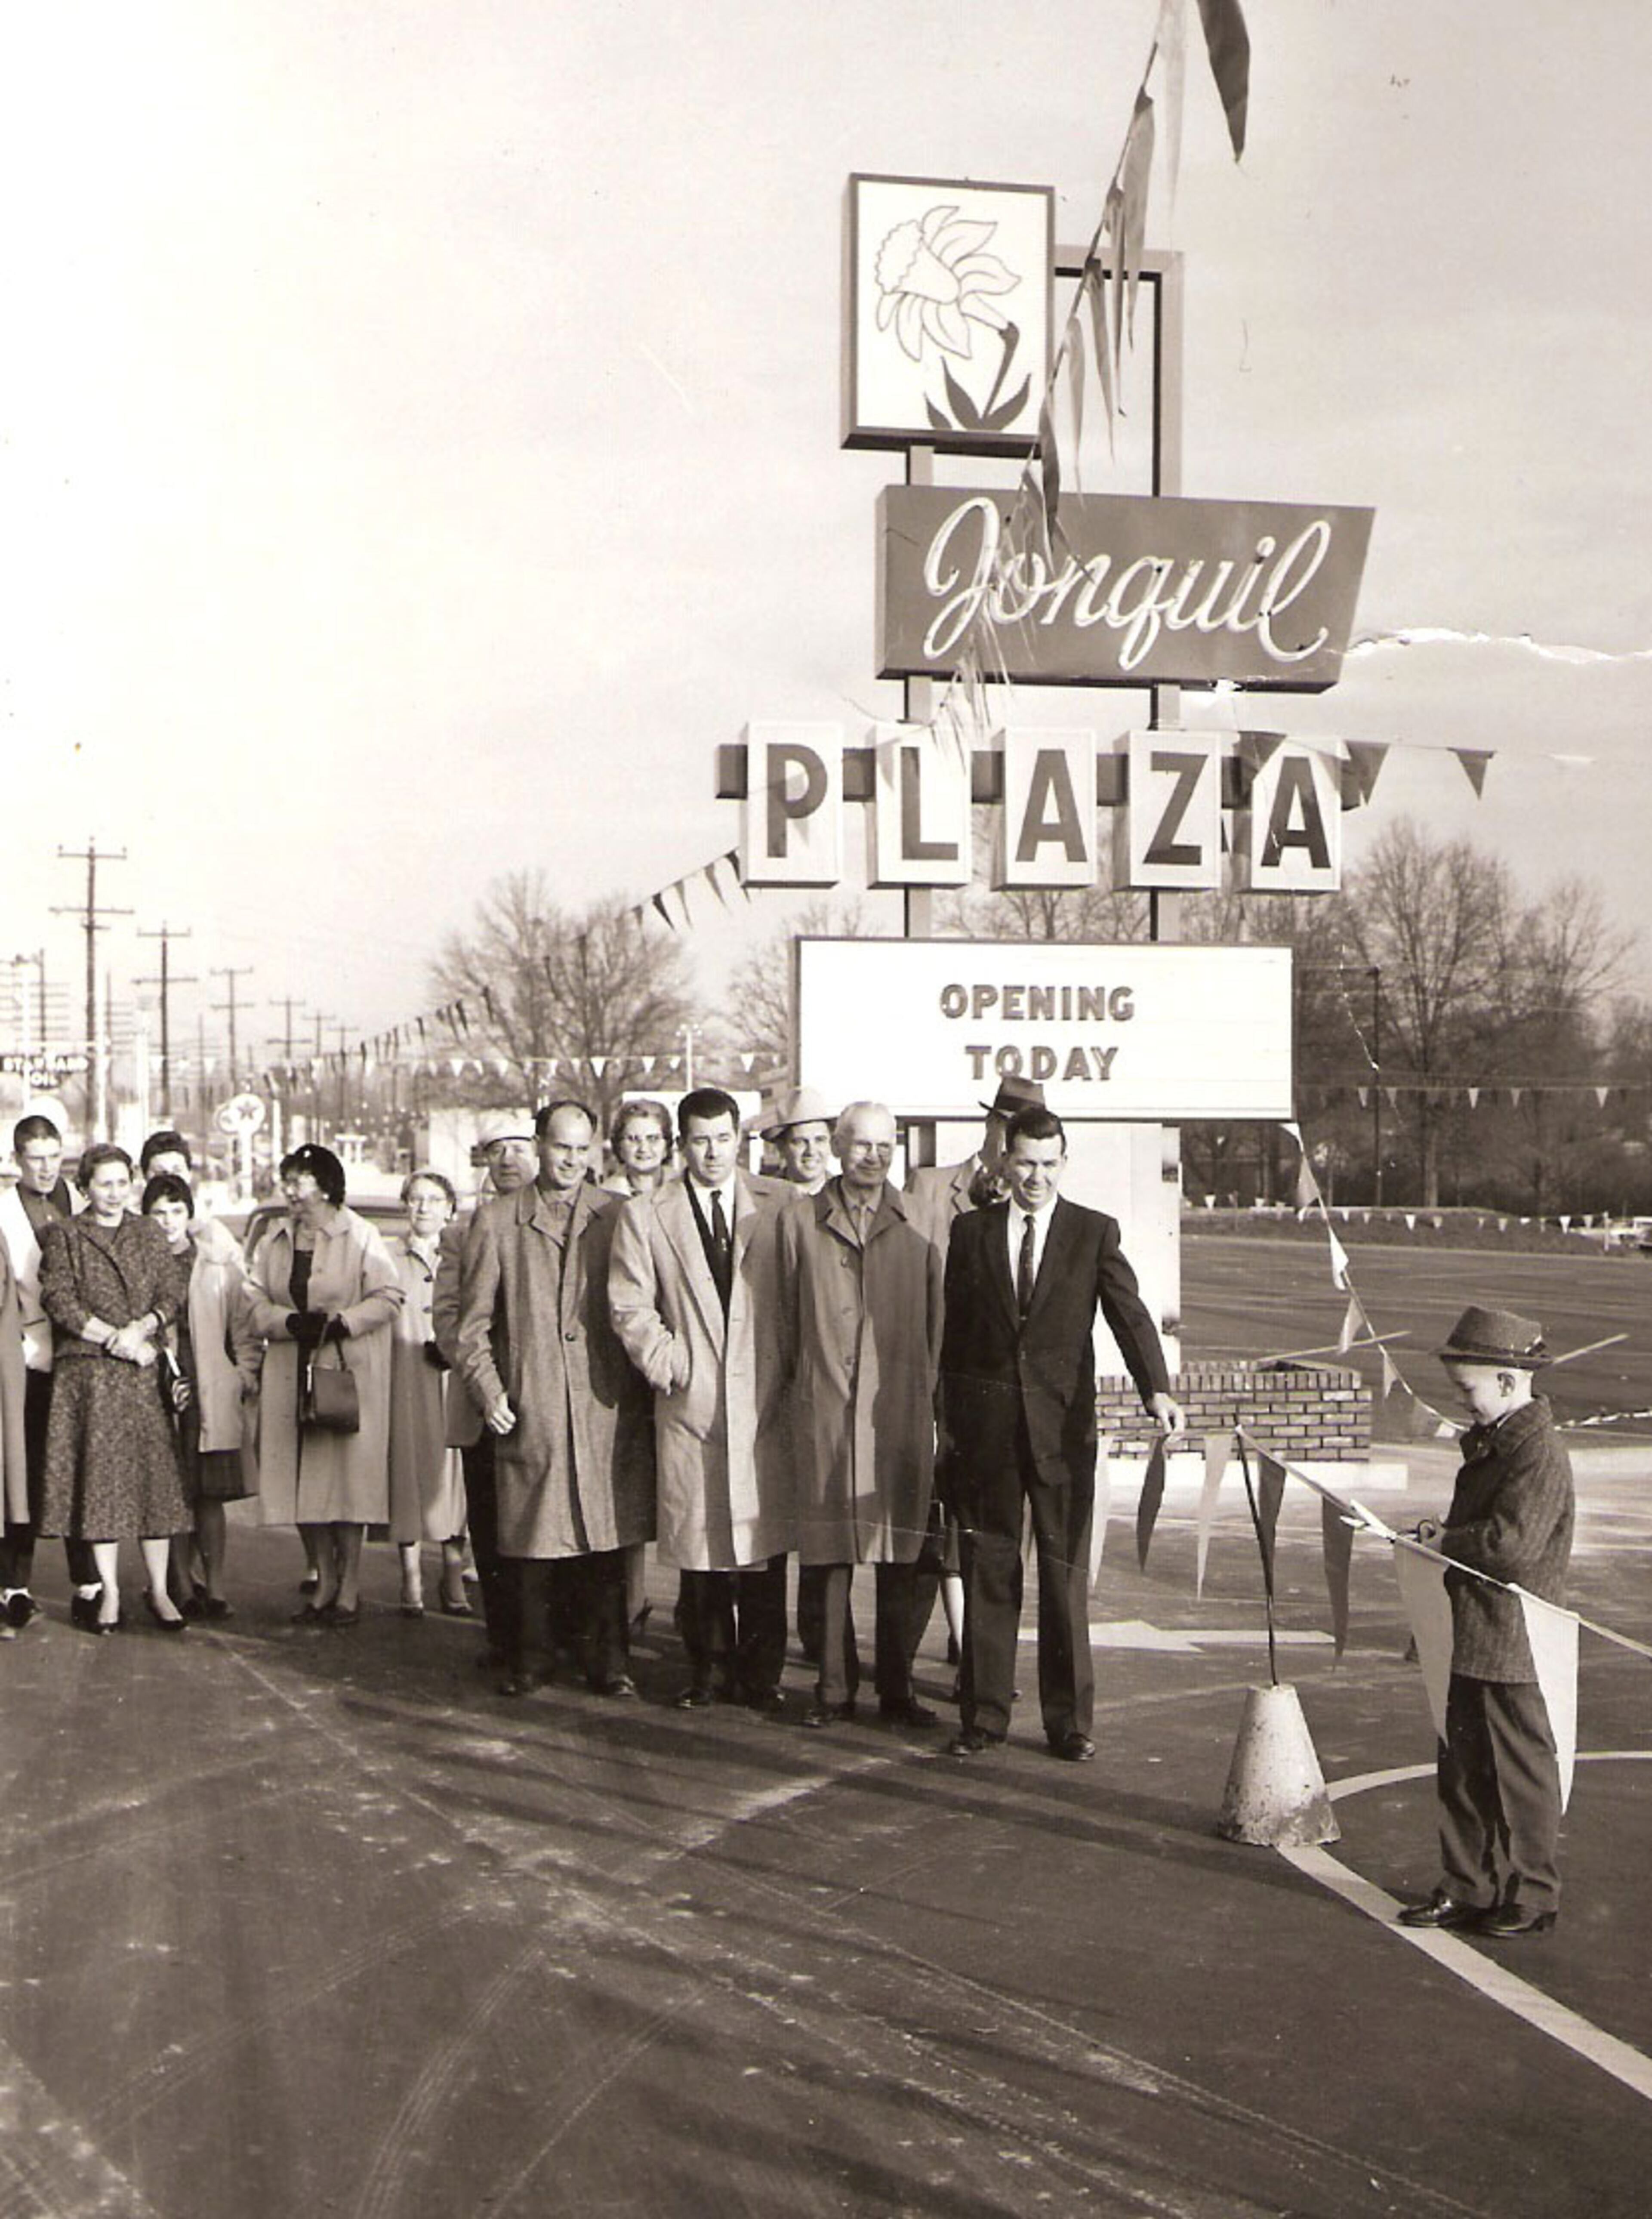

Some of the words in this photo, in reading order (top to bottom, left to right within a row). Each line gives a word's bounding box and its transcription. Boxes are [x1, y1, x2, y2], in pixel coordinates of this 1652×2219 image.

[923, 497, 1331, 671] Jonquil
[767, 743, 1331, 868] PLAZA
[940, 984, 1134, 1022] OPENING
[31, 1071, 58, 1085] OIL
[964, 1045, 1119, 1081] TODAY
